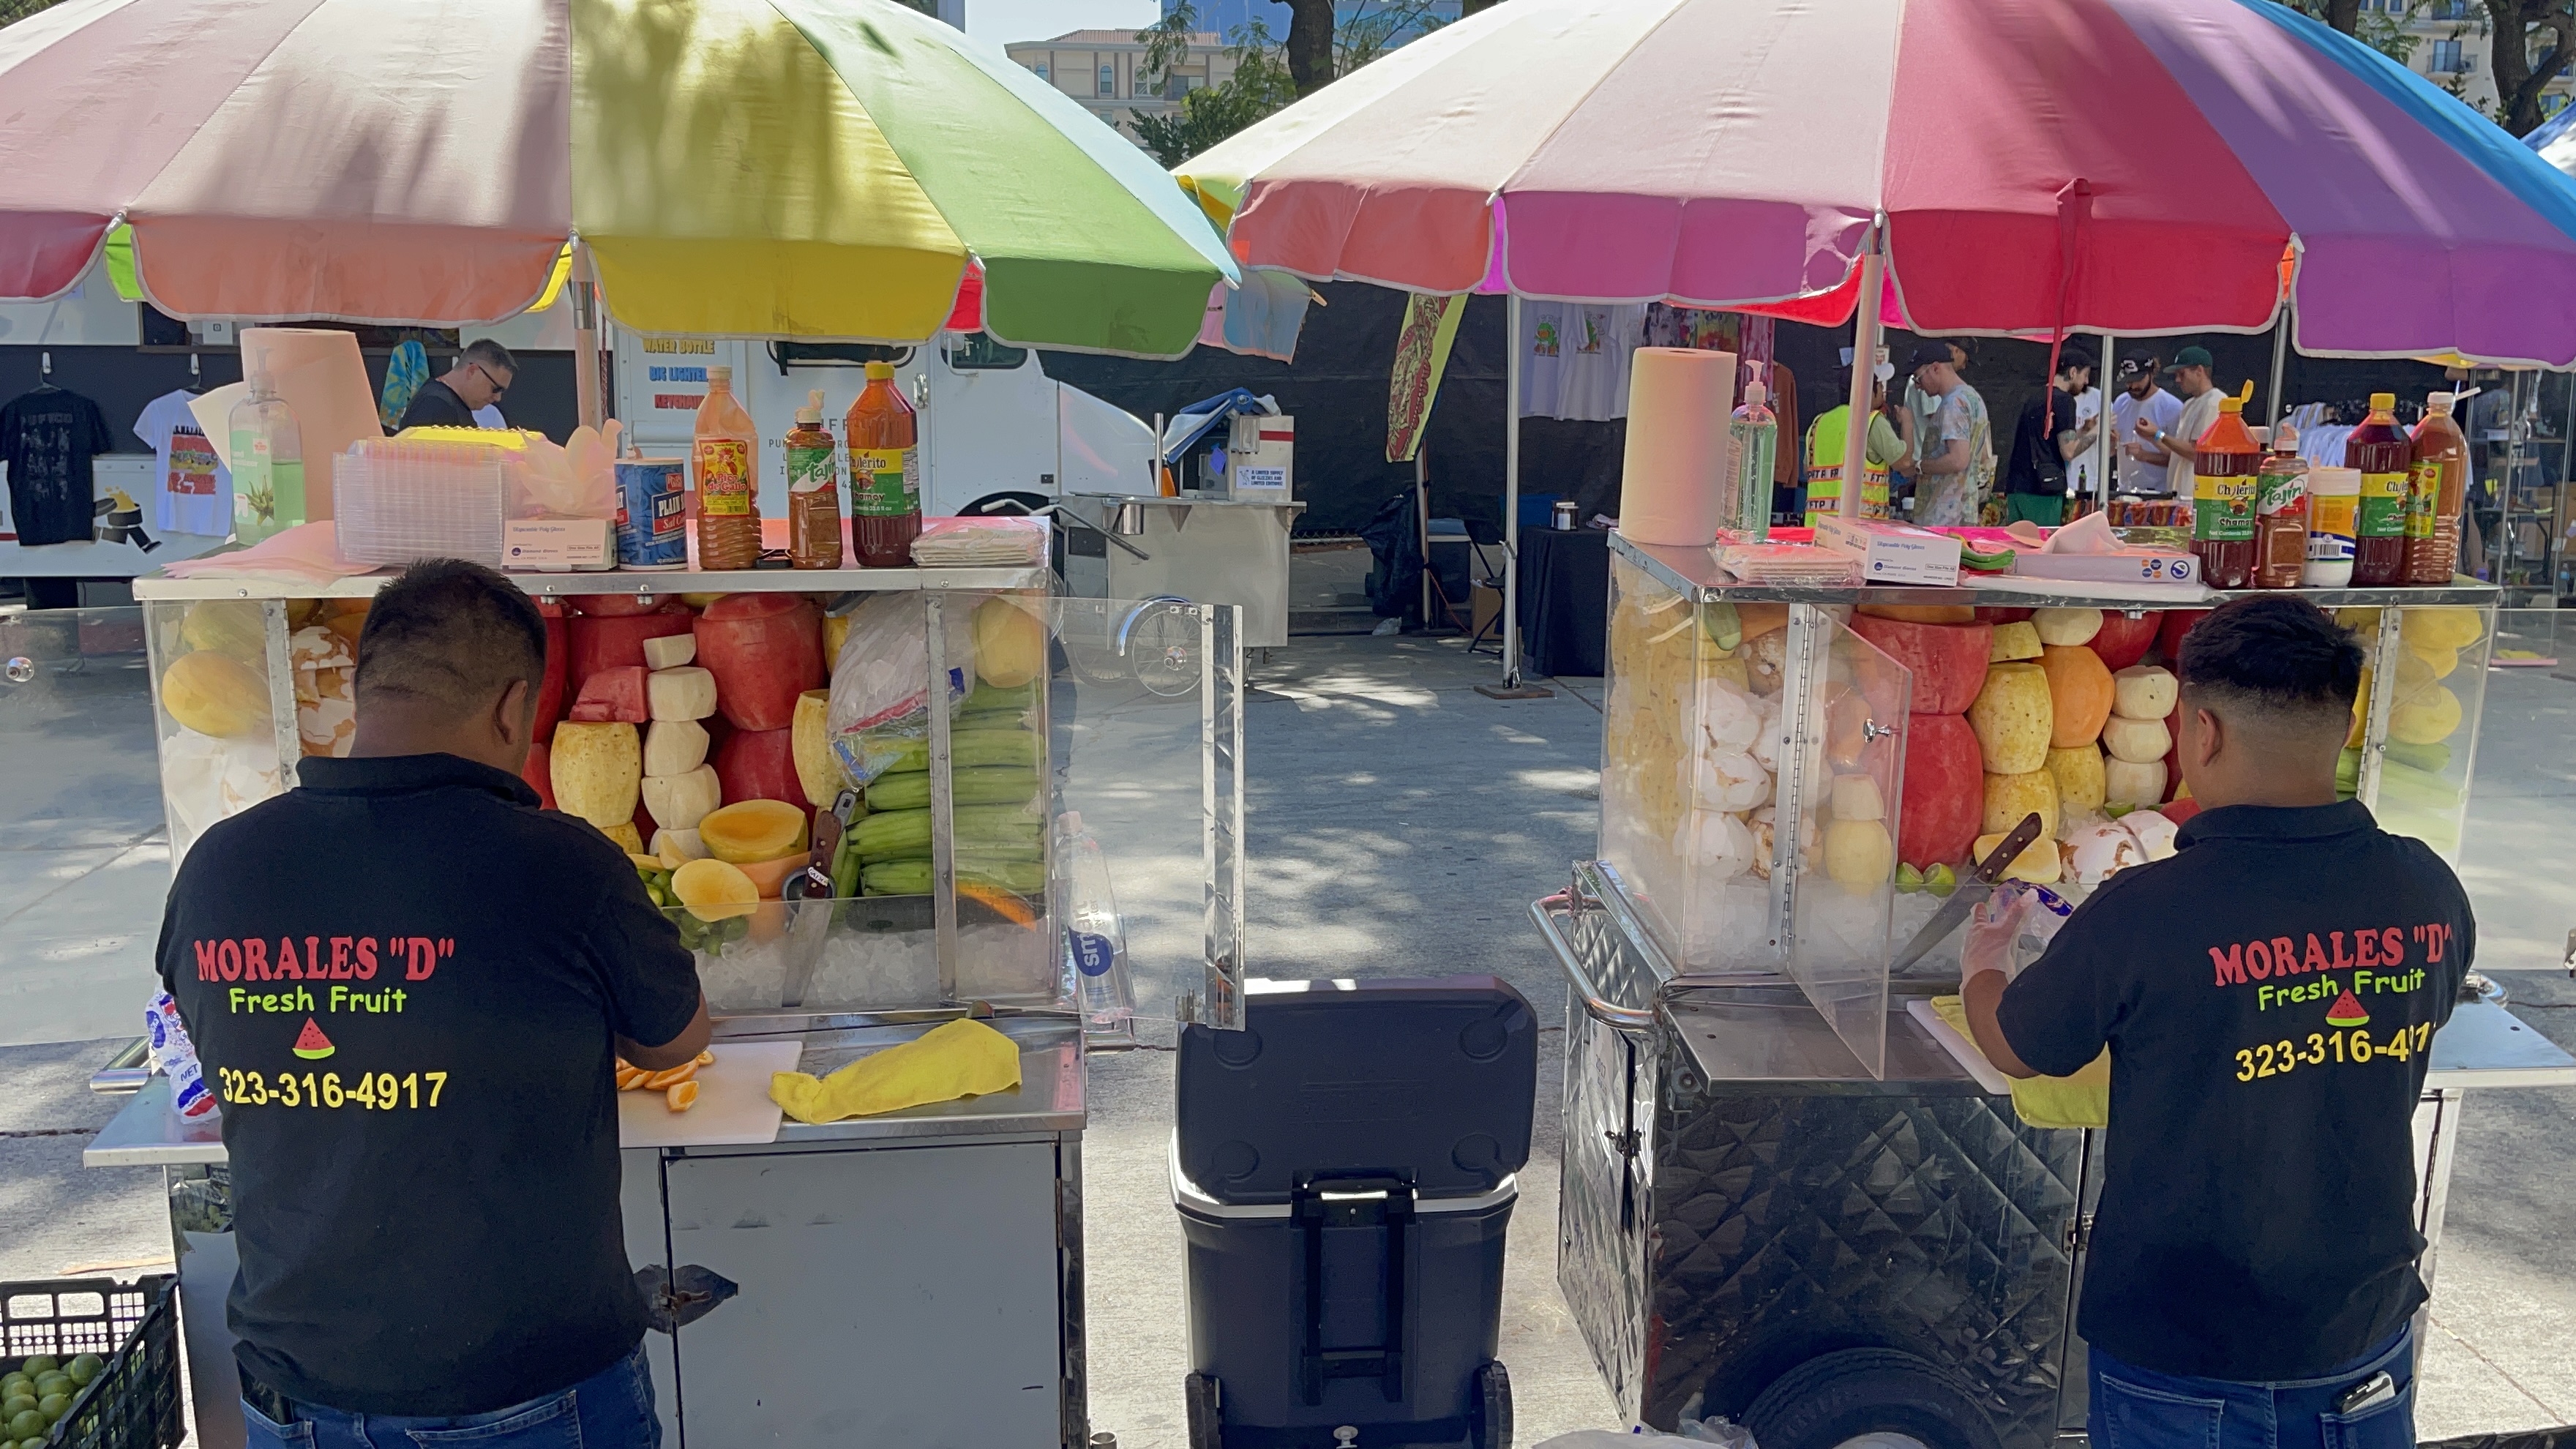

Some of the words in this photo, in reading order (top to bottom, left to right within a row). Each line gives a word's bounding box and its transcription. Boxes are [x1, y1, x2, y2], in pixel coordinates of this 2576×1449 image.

[643, 338, 677, 353] WATER
[679, 339, 715, 354] BOTTLE
[853, 491, 885, 501] hamoy
[1090, 899, 1103, 929] wter
[194, 935, 378, 982] MORALES
[390, 936, 454, 981] "D"
[2209, 926, 2404, 987] MORALES
[2414, 924, 2453, 963] "D"
[229, 985, 315, 1014] Fresh
[330, 985, 407, 1014] Fruit
[2258, 974, 2339, 1012] Fresh
[2354, 968, 2426, 995] Fruit
[180, 1063, 198, 1082] NET
[220, 1067, 448, 1110] 323-316-4917
